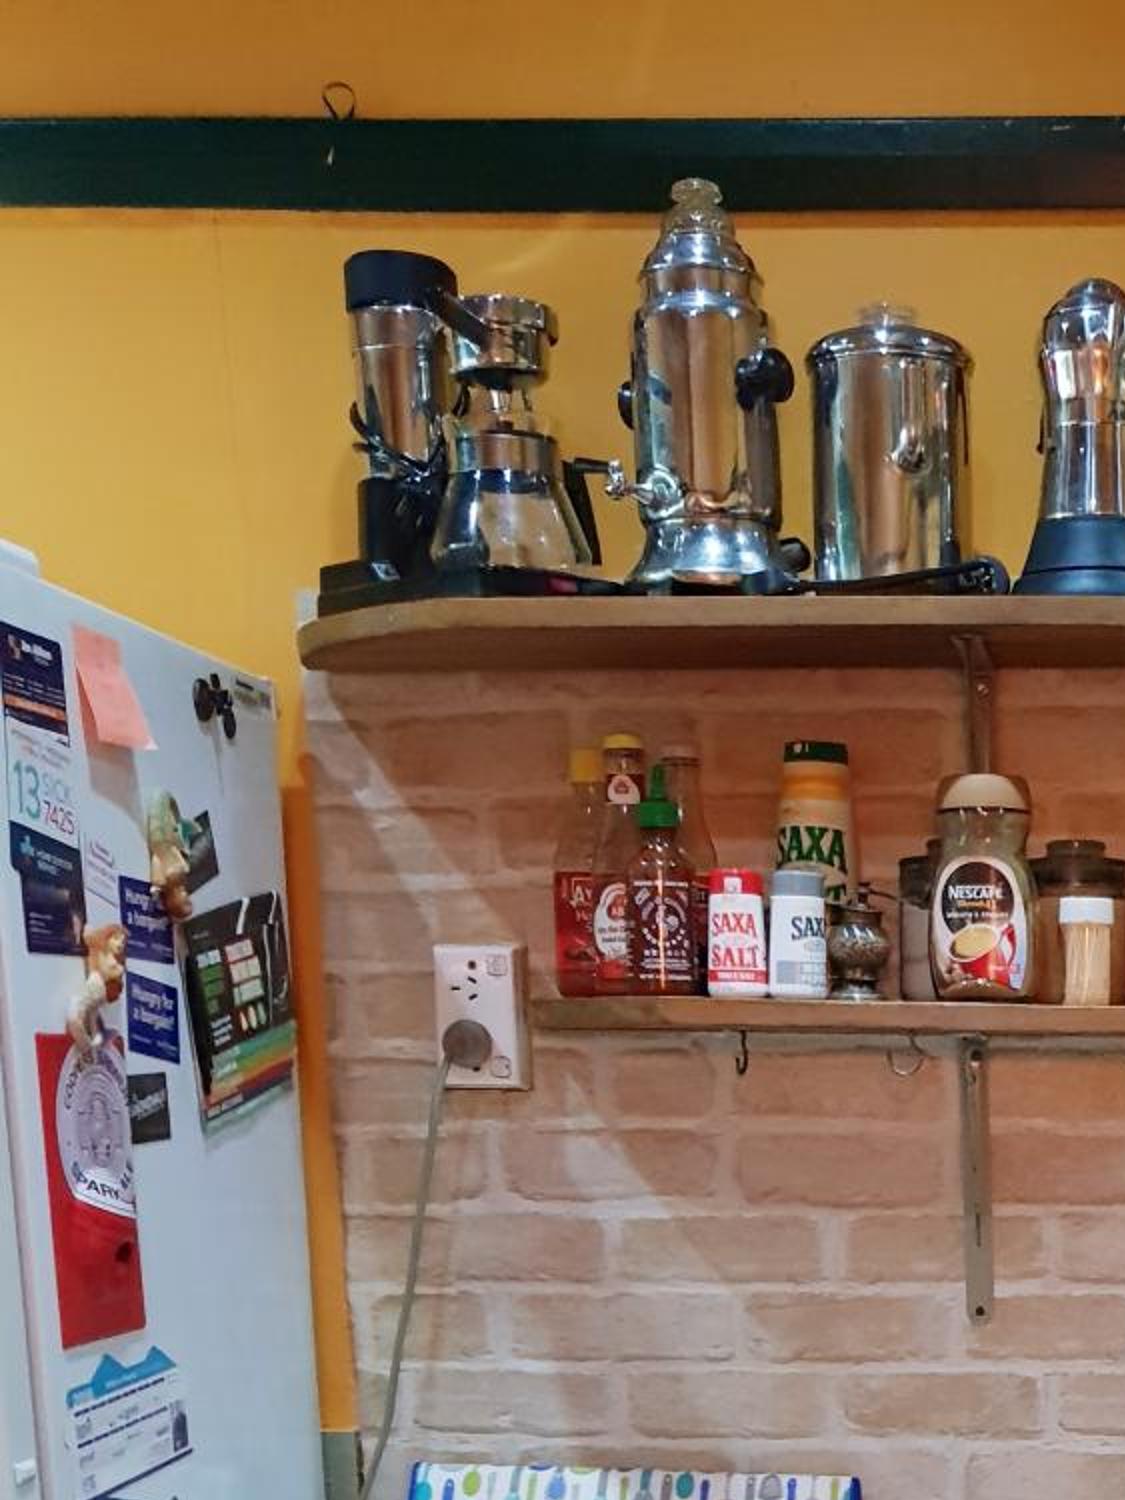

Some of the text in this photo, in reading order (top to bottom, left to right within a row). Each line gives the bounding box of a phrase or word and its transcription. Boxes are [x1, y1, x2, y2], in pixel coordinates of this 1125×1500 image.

[775, 825, 848, 874] SAXA
[711, 912, 757, 937] SAXA
[791, 915, 825, 941] SAX
[711, 944, 760, 969] SALT
